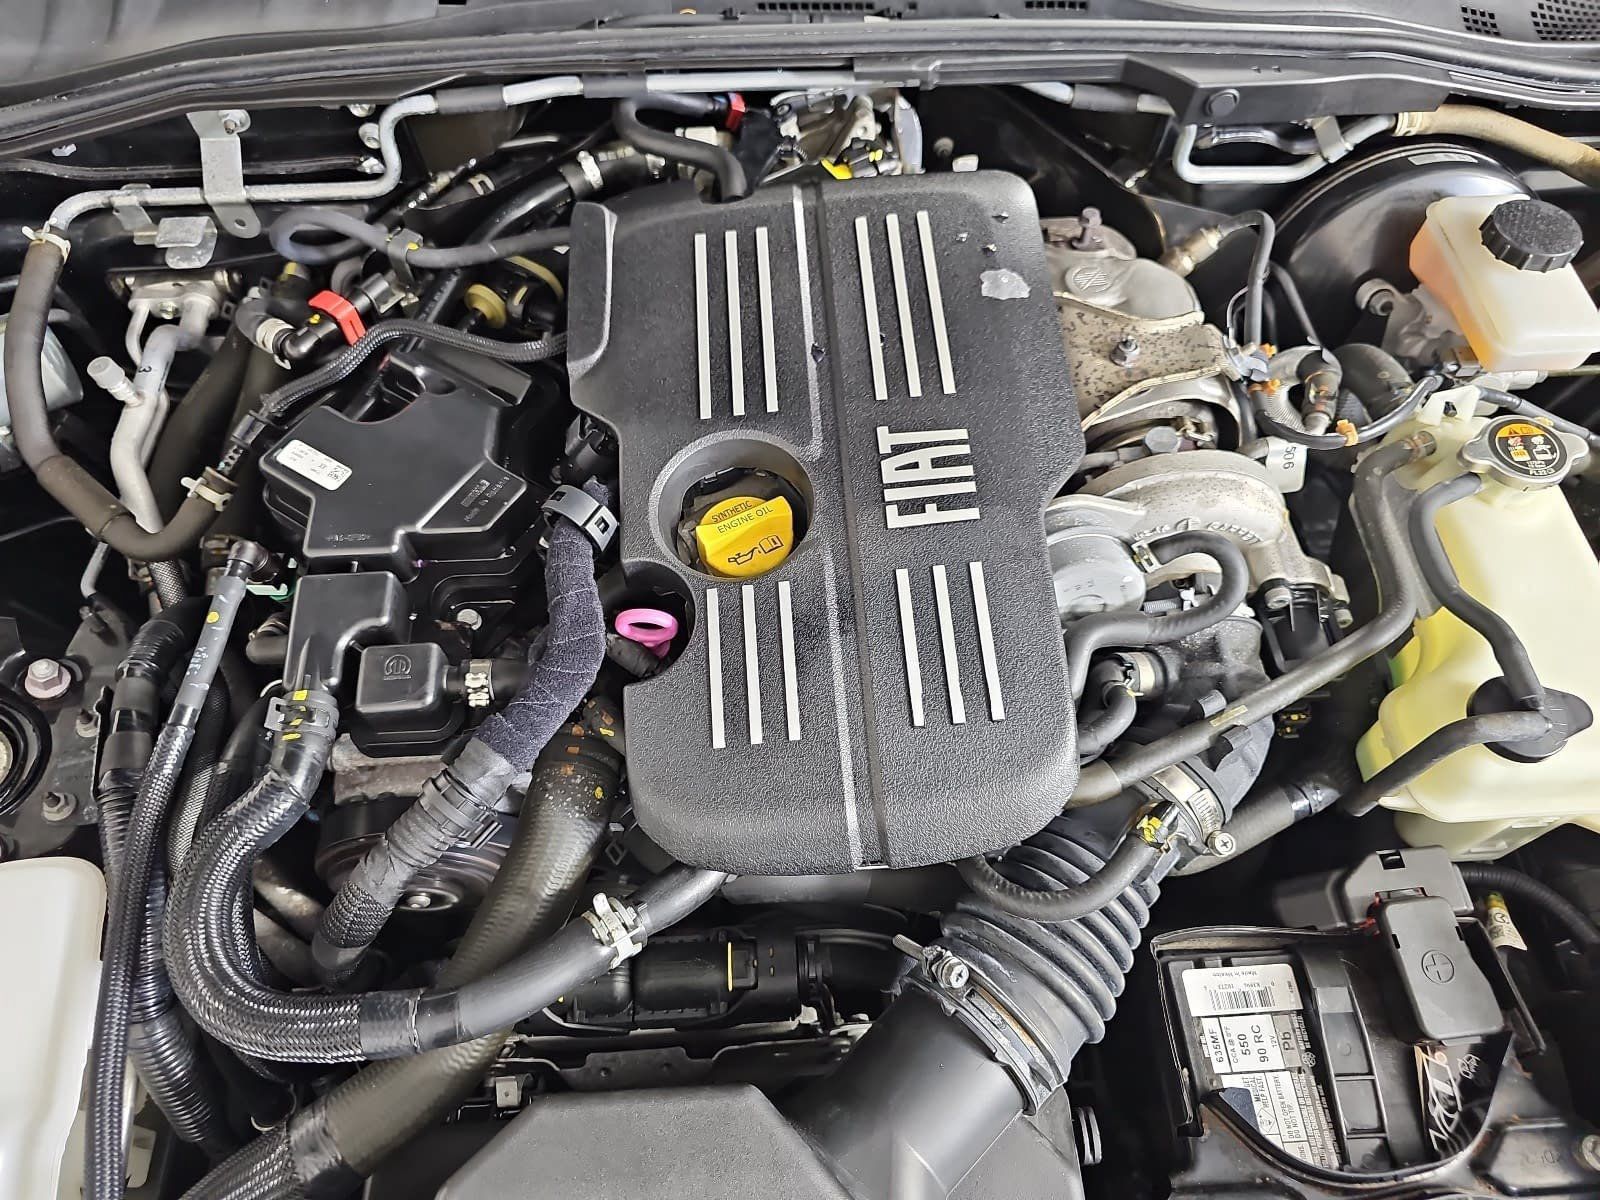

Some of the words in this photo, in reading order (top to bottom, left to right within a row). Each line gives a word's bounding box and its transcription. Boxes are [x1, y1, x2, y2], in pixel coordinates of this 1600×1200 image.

[877, 426, 980, 529] FIAT
[711, 500, 753, 523] SYNTHETIC
[717, 513, 755, 534] ENGINE
[755, 505, 774, 517] OIL
[1237, 1033, 1251, 1056] 550
[1250, 1024, 1264, 1044] RC
[1269, 1034, 1279, 1049] 12V
[1281, 1031, 1295, 1051] Pb
[1208, 1028, 1224, 1063] 635MF
[1230, 1047, 1239, 1064] CCA
[1257, 1048, 1269, 1062] 90
